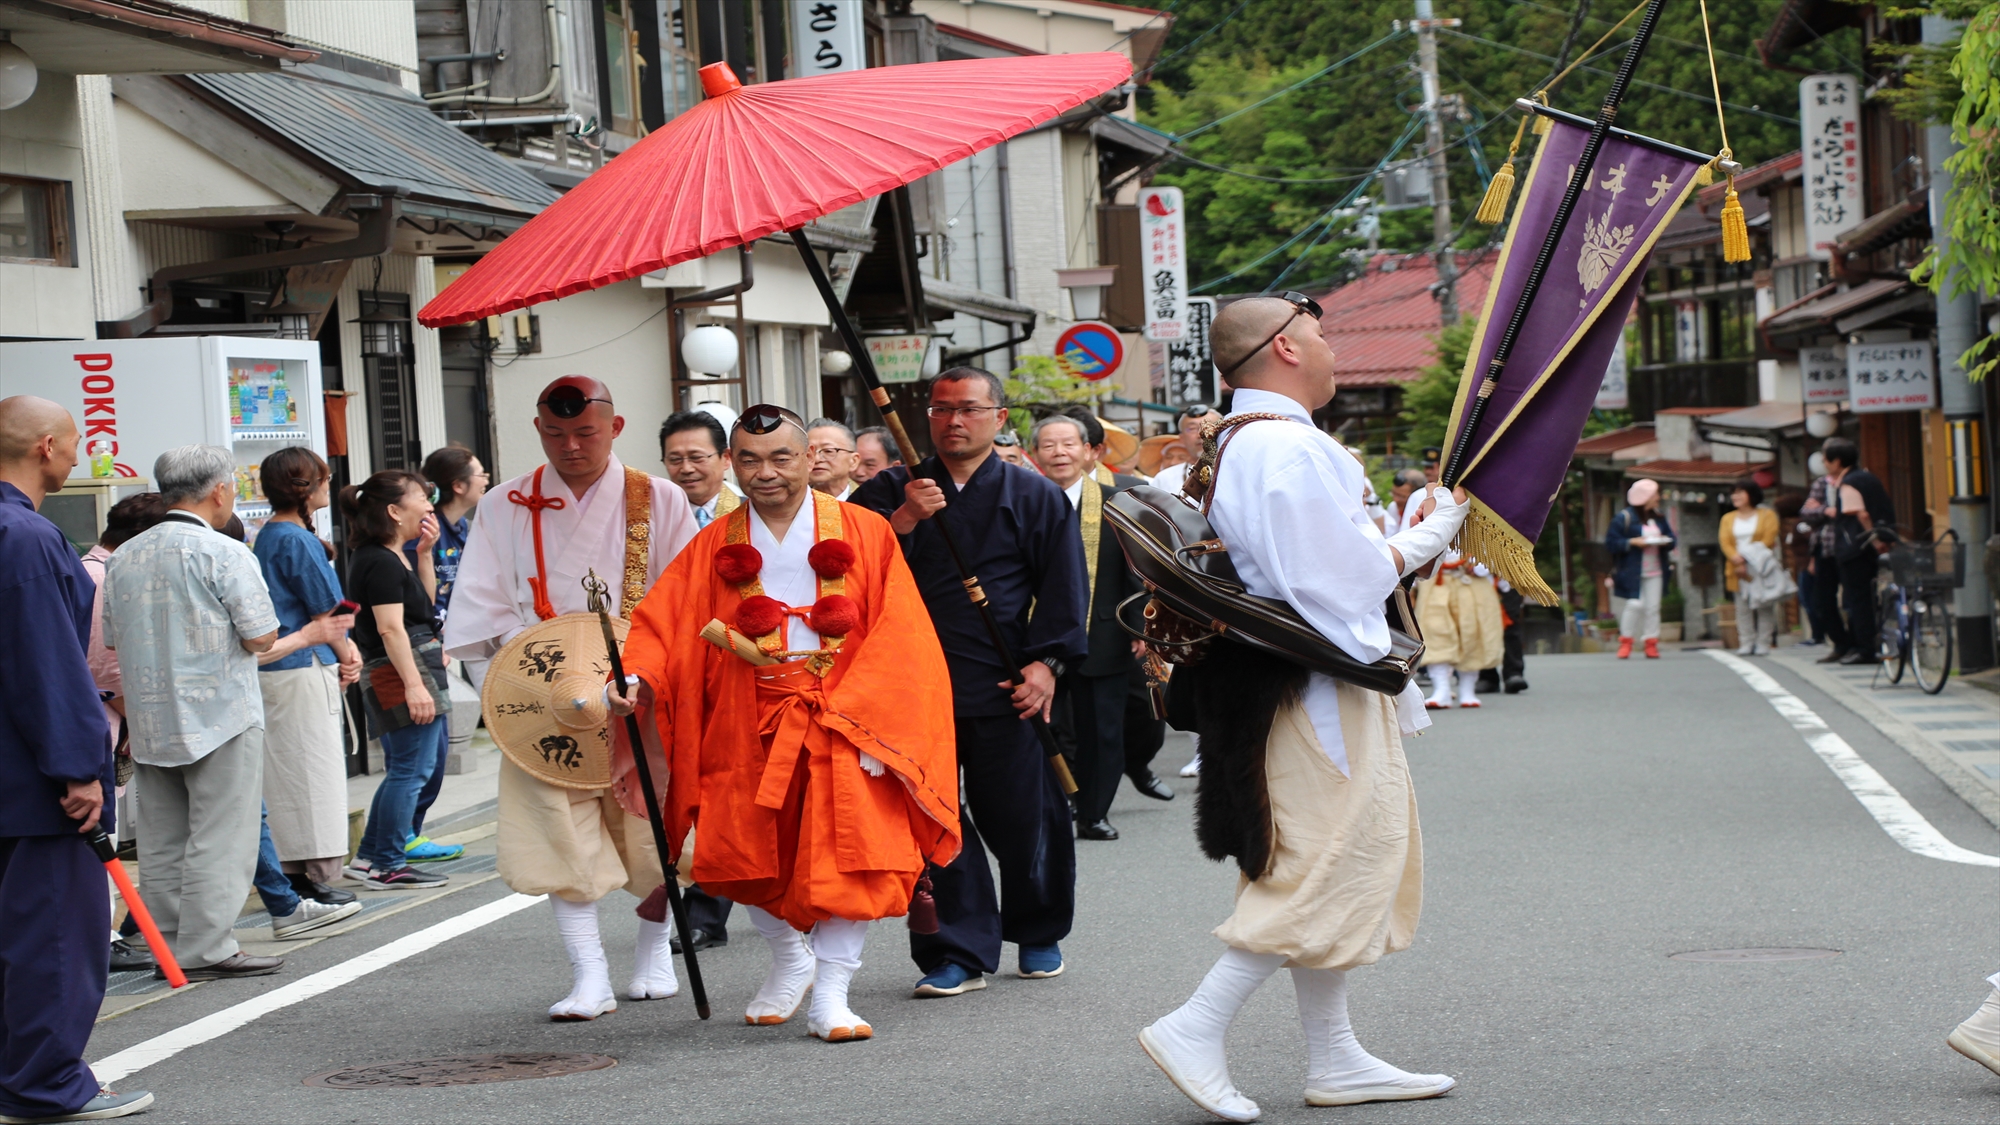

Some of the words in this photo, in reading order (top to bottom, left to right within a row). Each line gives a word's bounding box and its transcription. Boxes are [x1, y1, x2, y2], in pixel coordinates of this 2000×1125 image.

[808, 2, 843, 69] さら
[1824, 116, 1848, 224] だらにすけ
[1151, 268, 1178, 319] 魚富
[870, 337, 924, 352] 洞川温泉
[1859, 347, 1922, 362] だらにすけ
[1857, 368, 1928, 384] 増谷久八
